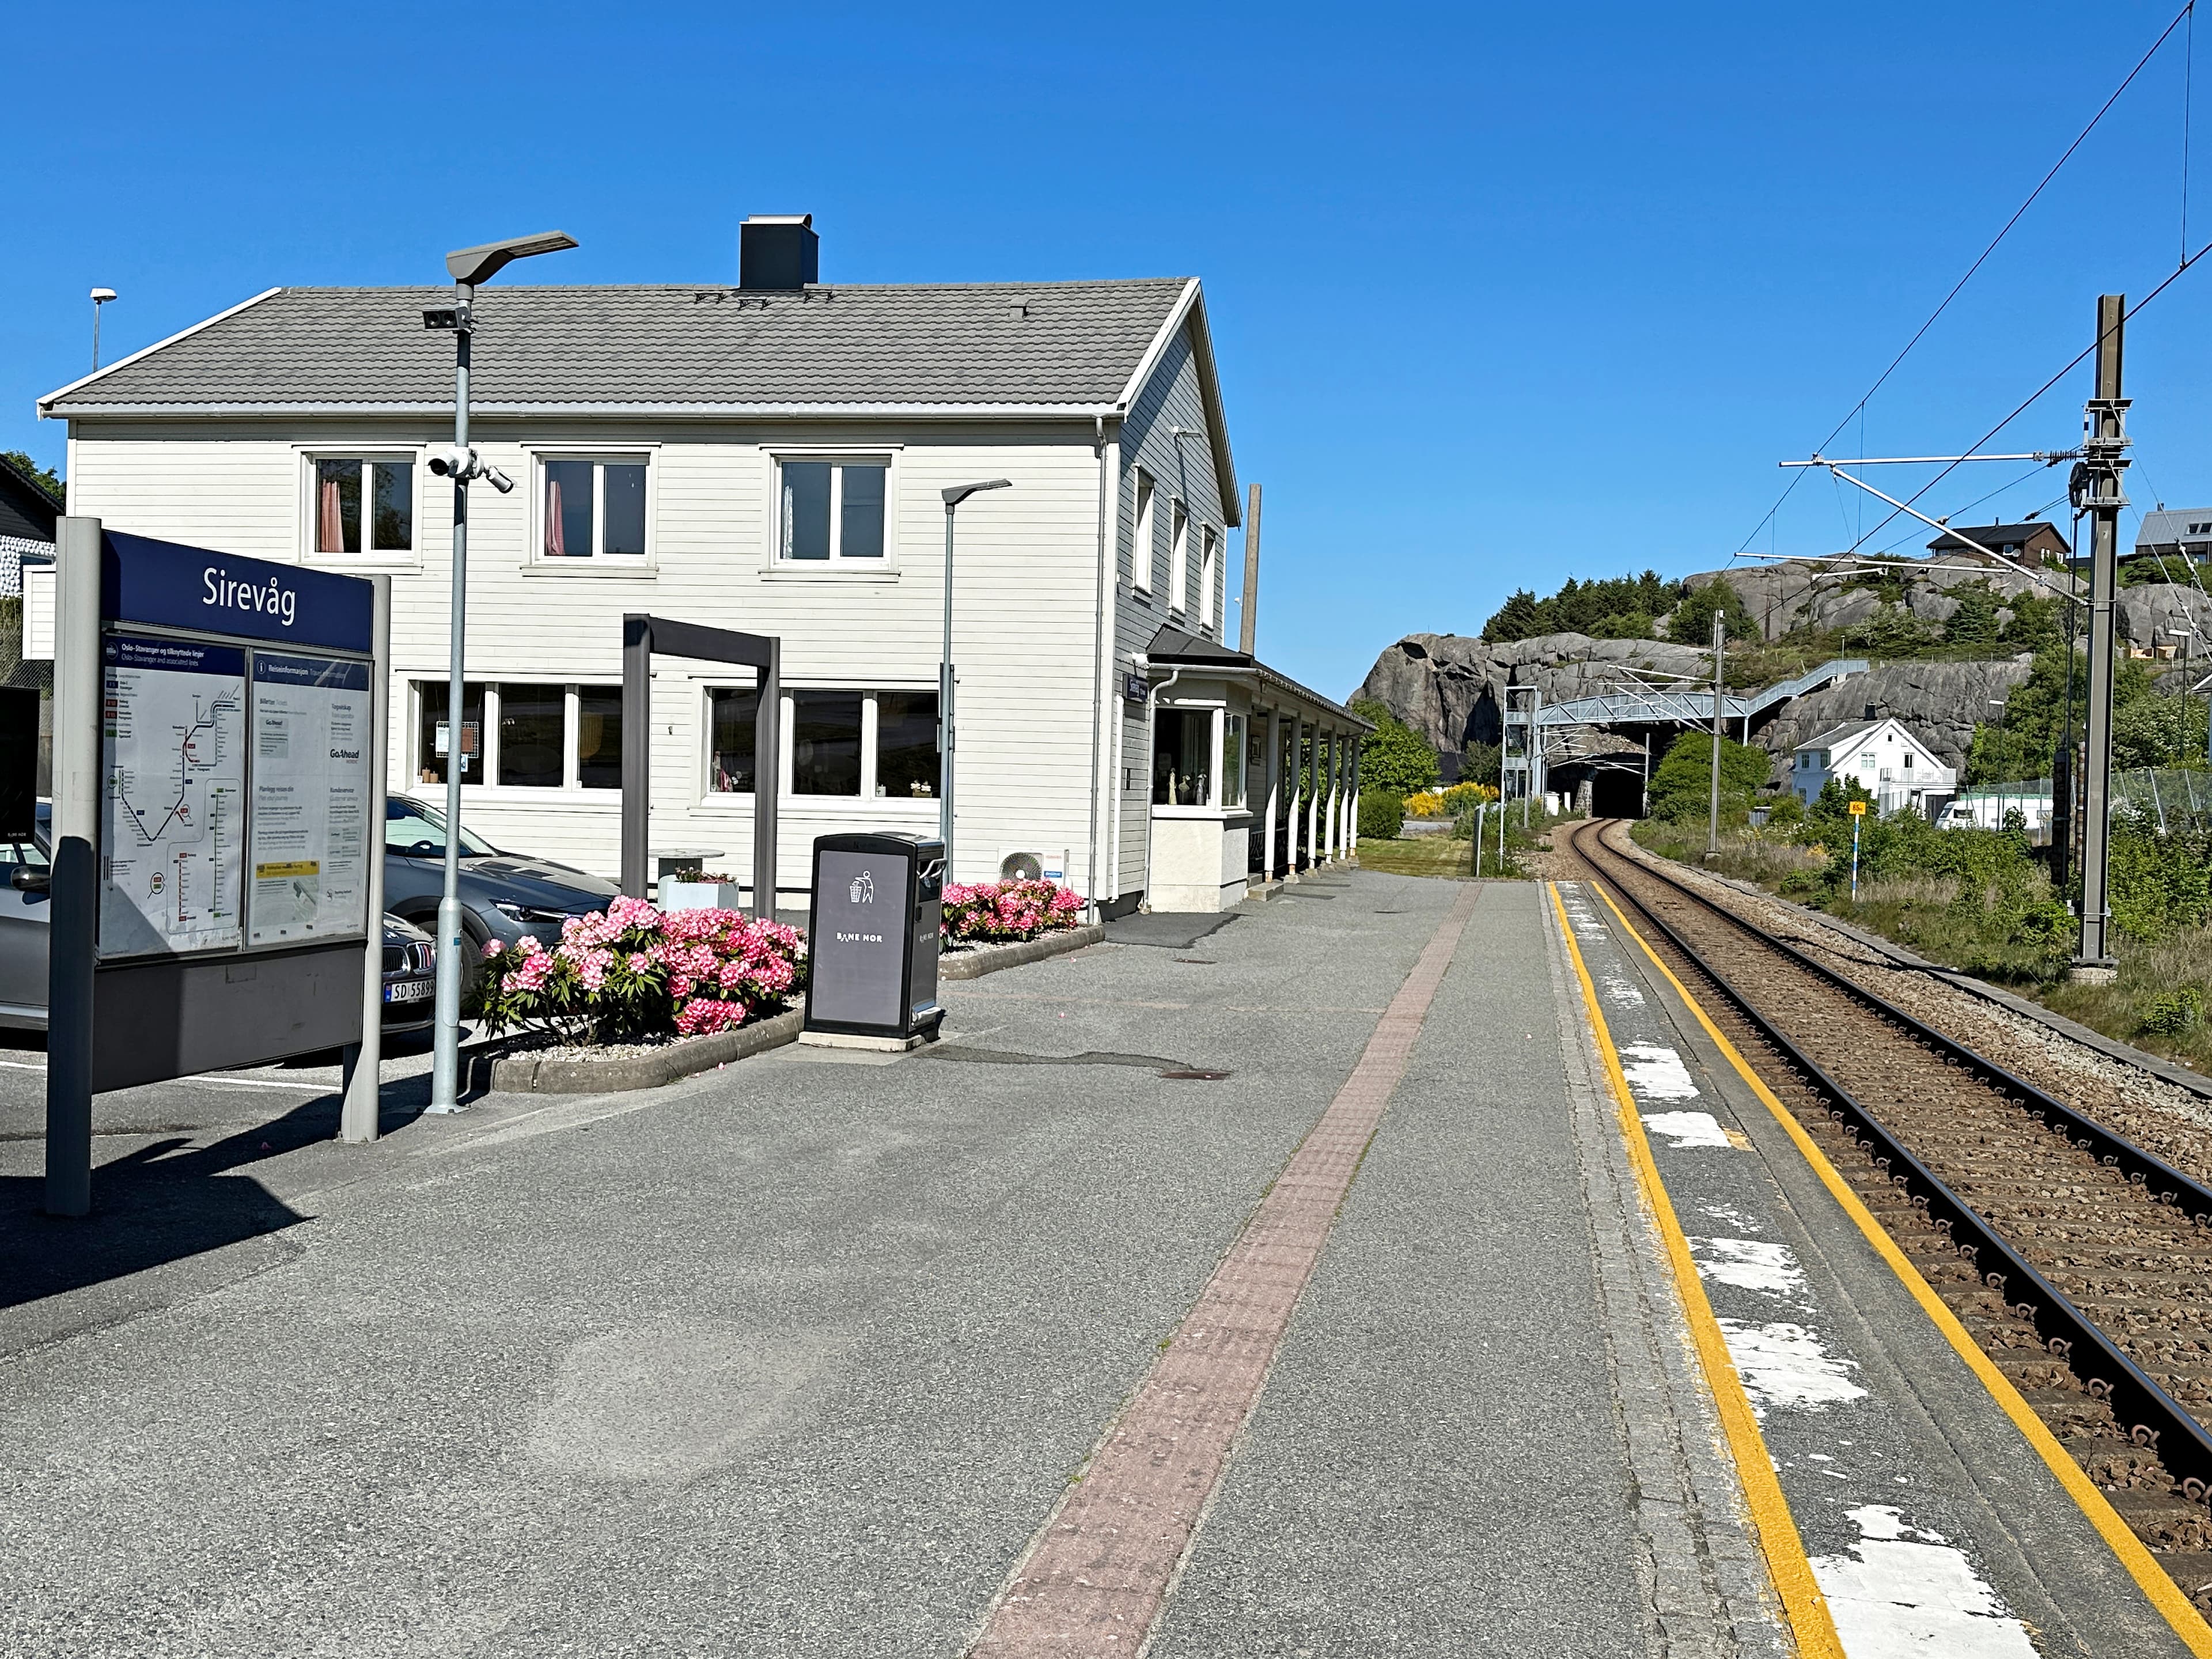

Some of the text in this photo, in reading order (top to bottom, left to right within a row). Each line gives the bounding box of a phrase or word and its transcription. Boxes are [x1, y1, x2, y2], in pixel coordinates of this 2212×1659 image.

[203, 567, 296, 626] Sirevåg
[836, 932, 882, 943] BANE NOR
[395, 980, 434, 999] SD 55899
